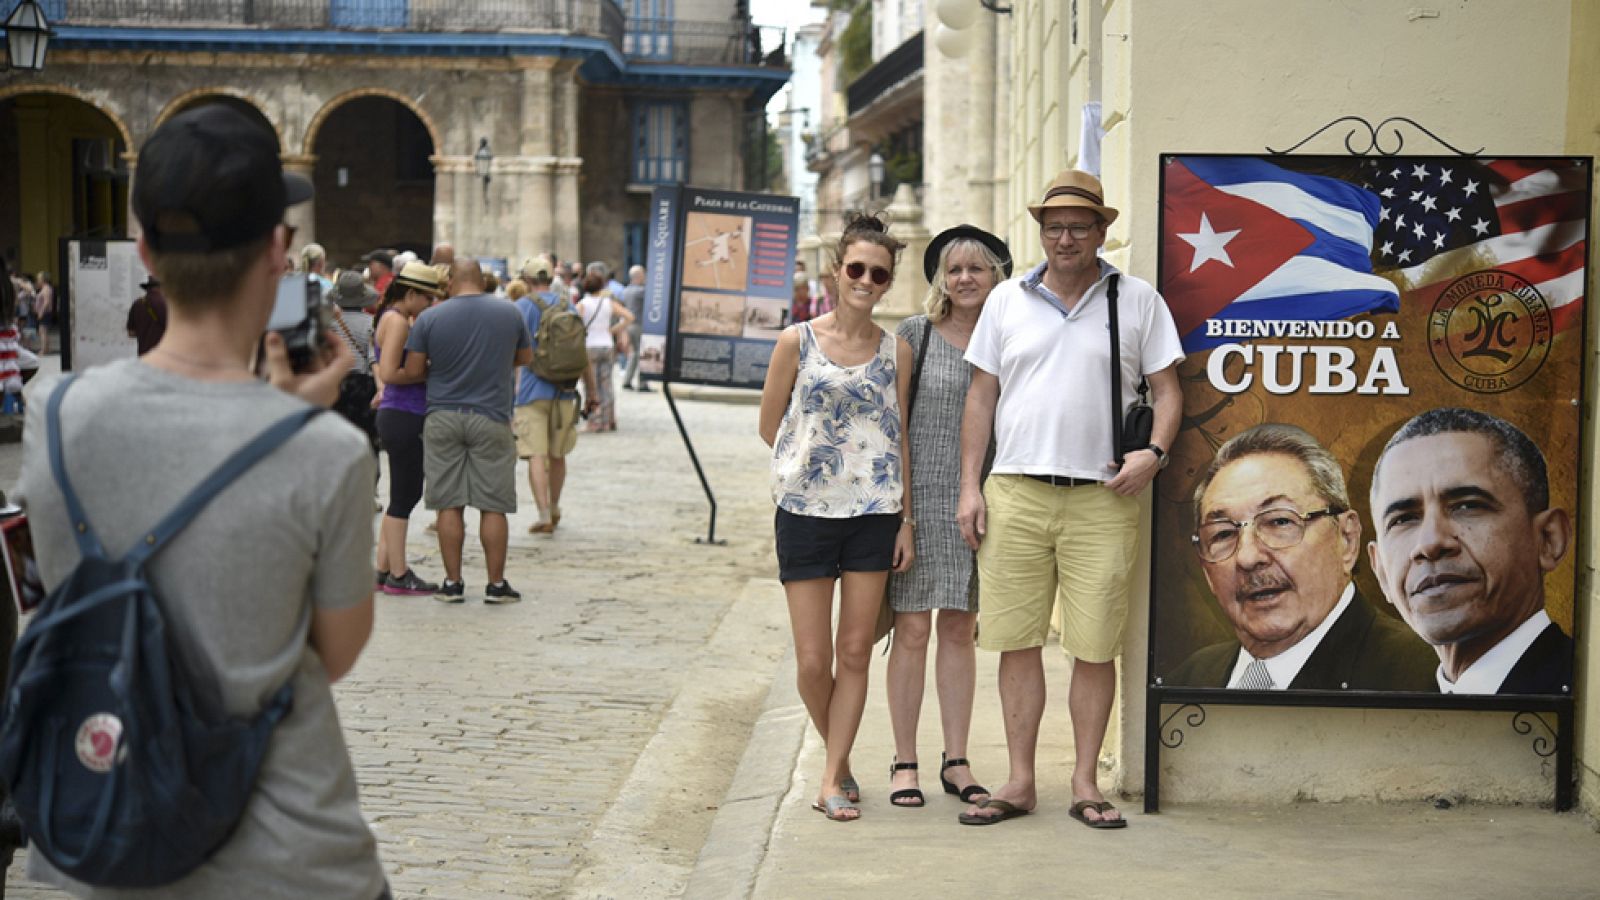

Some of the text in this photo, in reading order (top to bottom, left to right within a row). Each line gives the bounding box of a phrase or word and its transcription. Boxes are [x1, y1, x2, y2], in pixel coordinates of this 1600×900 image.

[694, 195, 793, 214] PLAZA DE LA CATEDRAL
[648, 200, 670, 323] CATHEDRAL SQUARE
[1432, 308, 1451, 327] LA
[1445, 274, 1505, 304] MONEDA
[1511, 280, 1549, 333] CUBANA
[1205, 319, 1401, 339] BIENVENIDO A
[1206, 343, 1410, 394] CUBA
[1464, 375, 1509, 390] CUBA
